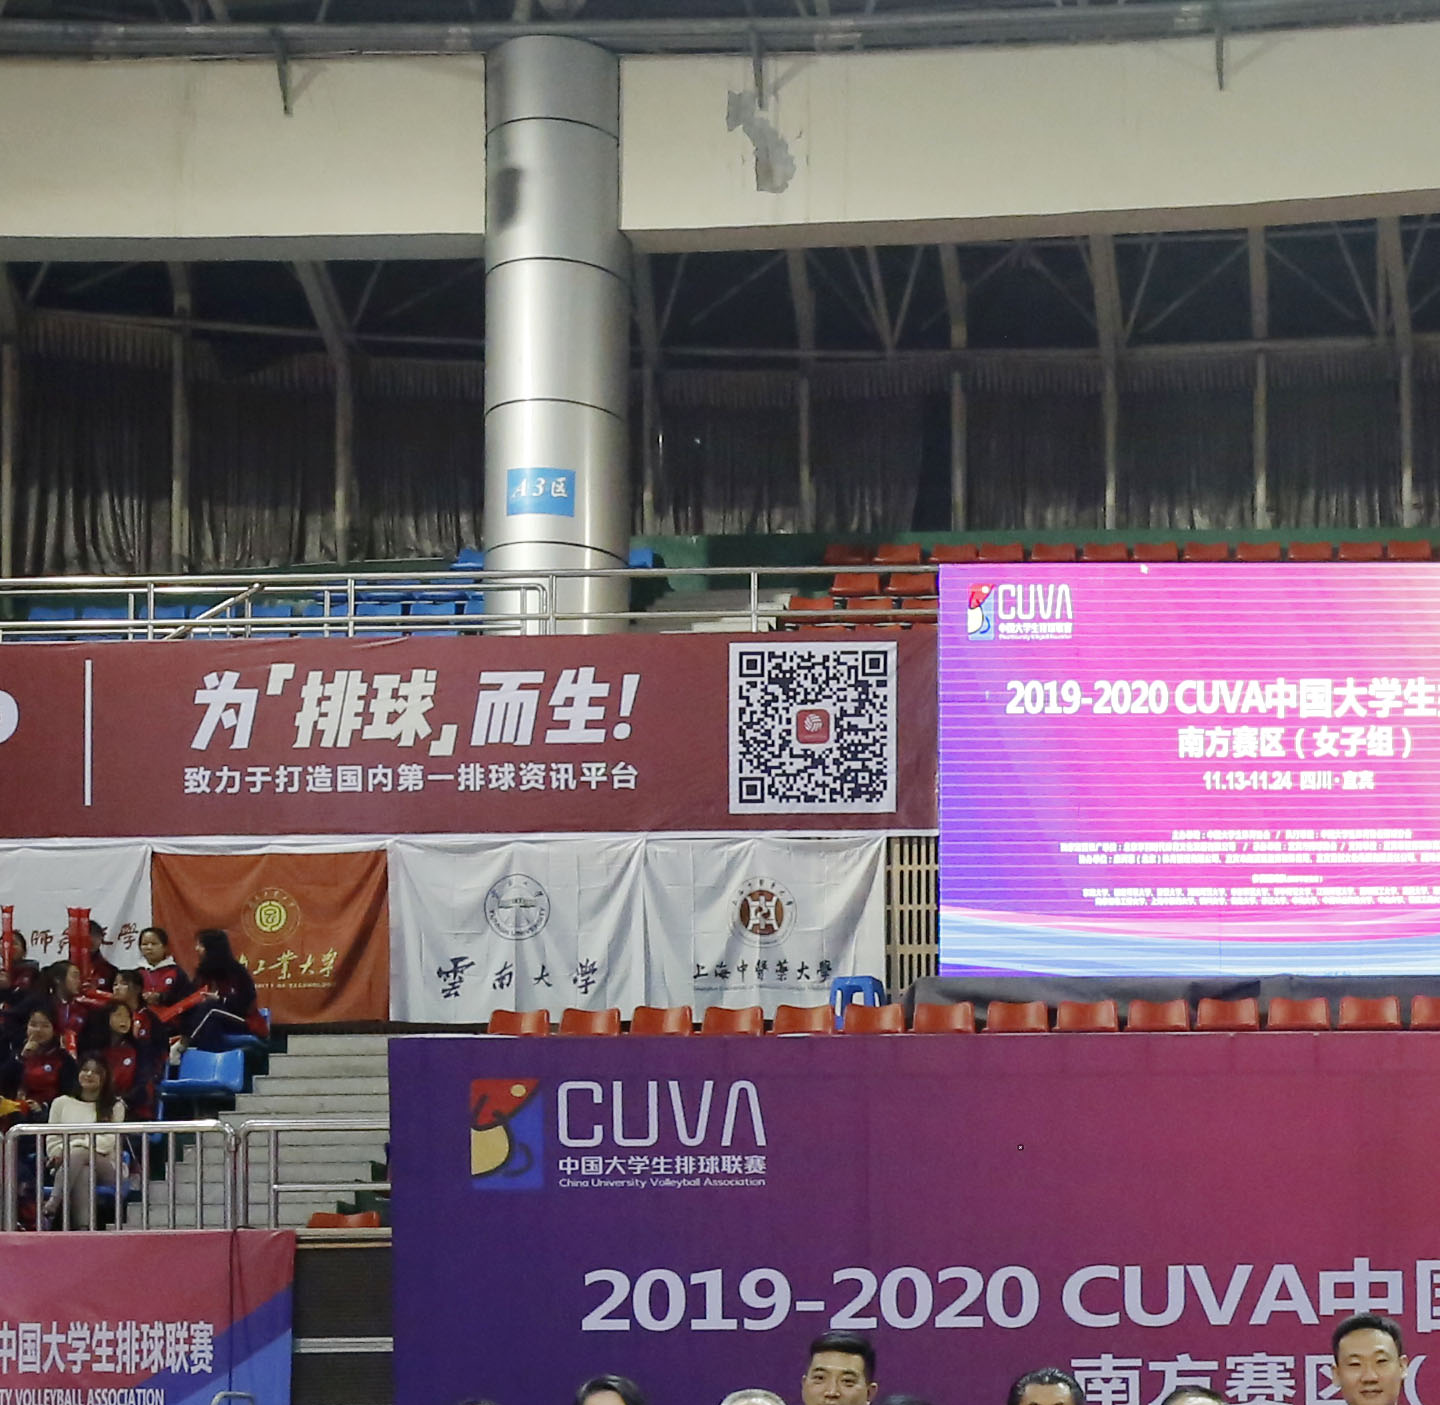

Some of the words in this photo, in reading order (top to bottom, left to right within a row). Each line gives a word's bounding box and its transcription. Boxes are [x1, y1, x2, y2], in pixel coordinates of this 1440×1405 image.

[998, 584, 1073, 620] CUVA
[1005, 680, 1169, 714] 2019-2020
[183, 762, 639, 795] 致力于打造国内第一排球资讯平台
[1202, 771, 1292, 791] 11.13-11.24
[558, 1079, 768, 1148] CUVA
[558, 1155, 767, 1175] 中国大学生排球联赛
[559, 1177, 589, 1188] China
[591, 1177, 648, 1190] University
[649, 1177, 701, 1190] Volleyball
[703, 1177, 767, 1188] Association
[581, 1264, 1039, 1332] 2019-2020
